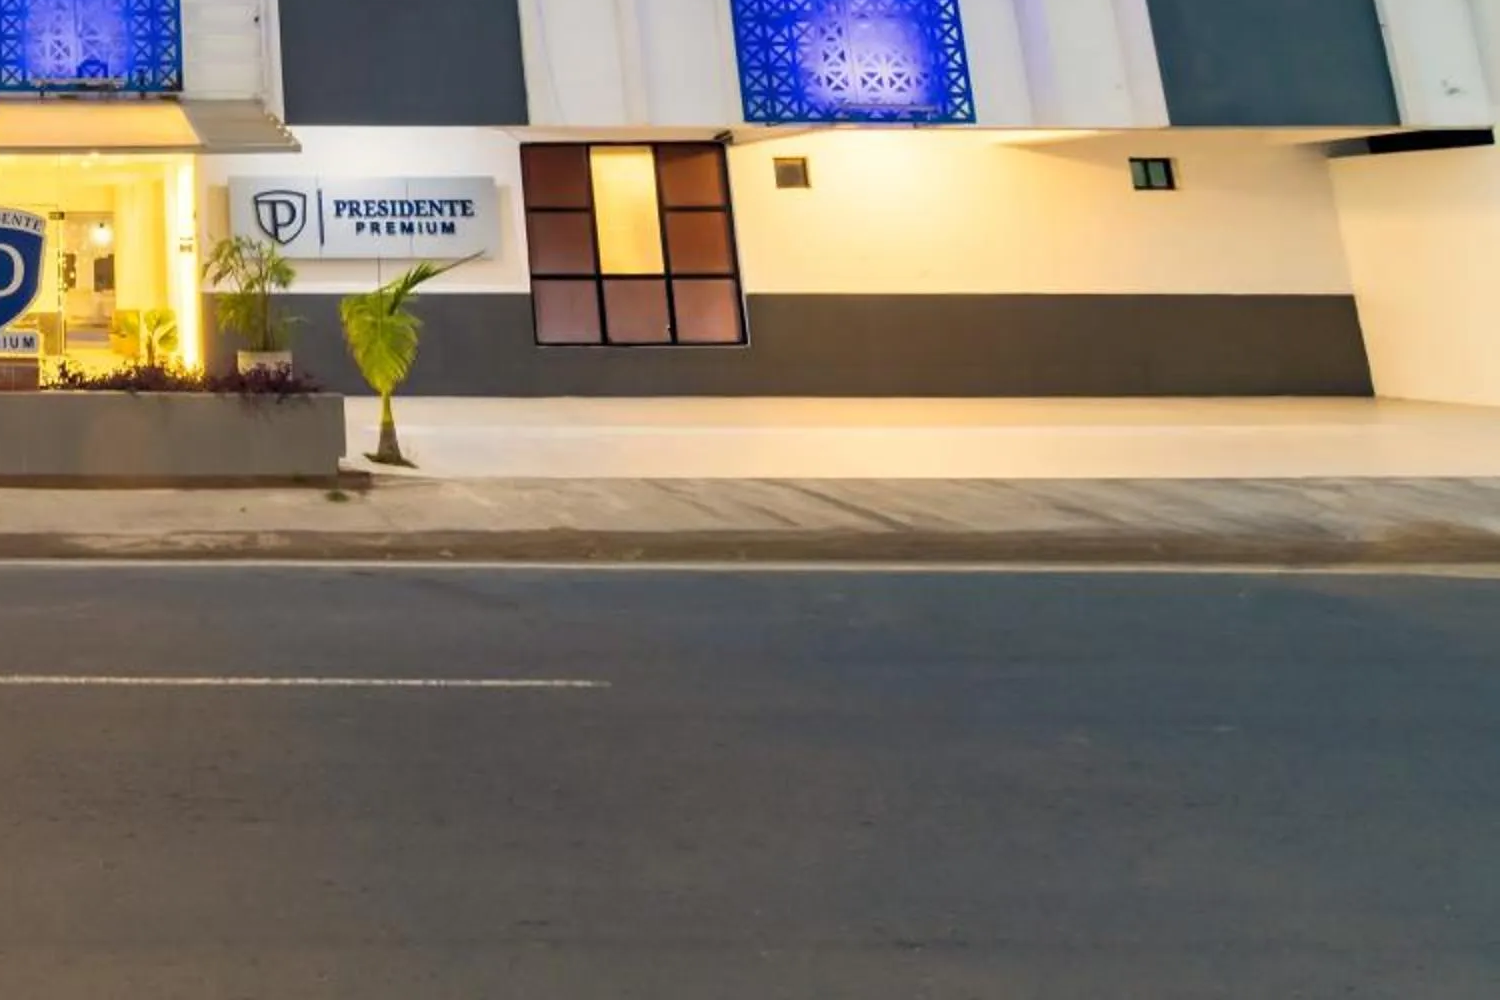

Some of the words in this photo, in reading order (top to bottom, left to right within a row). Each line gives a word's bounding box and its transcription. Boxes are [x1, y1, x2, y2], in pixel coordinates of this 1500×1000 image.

[335, 199, 474, 217] PRESIDENTE
[256, 199, 297, 240] P
[355, 221, 456, 235] PREMIUM
